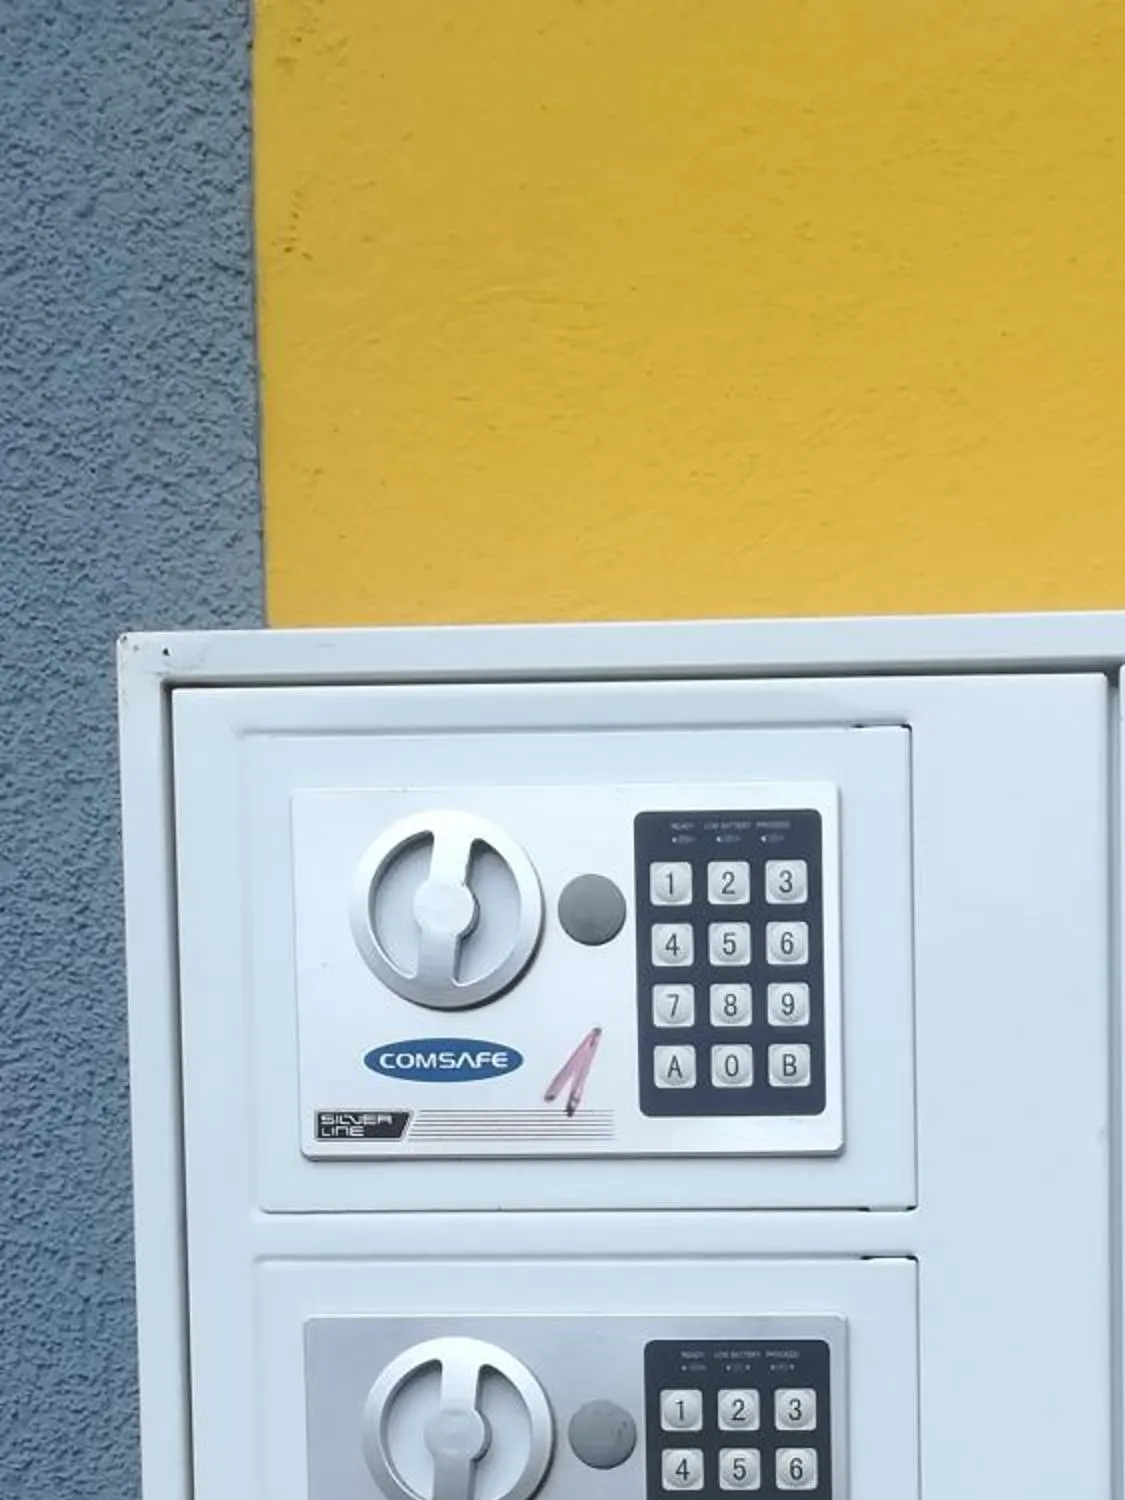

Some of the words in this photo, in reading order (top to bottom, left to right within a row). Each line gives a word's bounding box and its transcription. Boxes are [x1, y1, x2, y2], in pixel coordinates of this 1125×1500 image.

[722, 872, 735, 894] 2
[779, 870, 792, 893] 3
[666, 934, 680, 956] 4
[723, 933, 736, 955] 5
[781, 932, 794, 954] 6
[667, 994, 680, 1016] 7
[724, 994, 737, 1016] 8
[782, 993, 795, 1015] 9
[379, 1052, 508, 1069] COMSAFE
[668, 1056, 683, 1078] A
[725, 1055, 738, 1077] 0
[783, 1054, 797, 1076] B
[544, 1027, 602, 1118] 1
[320, 1115, 392, 1124] SILVER
[732, 1400, 745, 1420] 2
[789, 1399, 802, 1420] 3
[676, 1459, 689, 1480] 4
[733, 1458, 746, 1480] 5
[790, 1458, 803, 1480] 6
